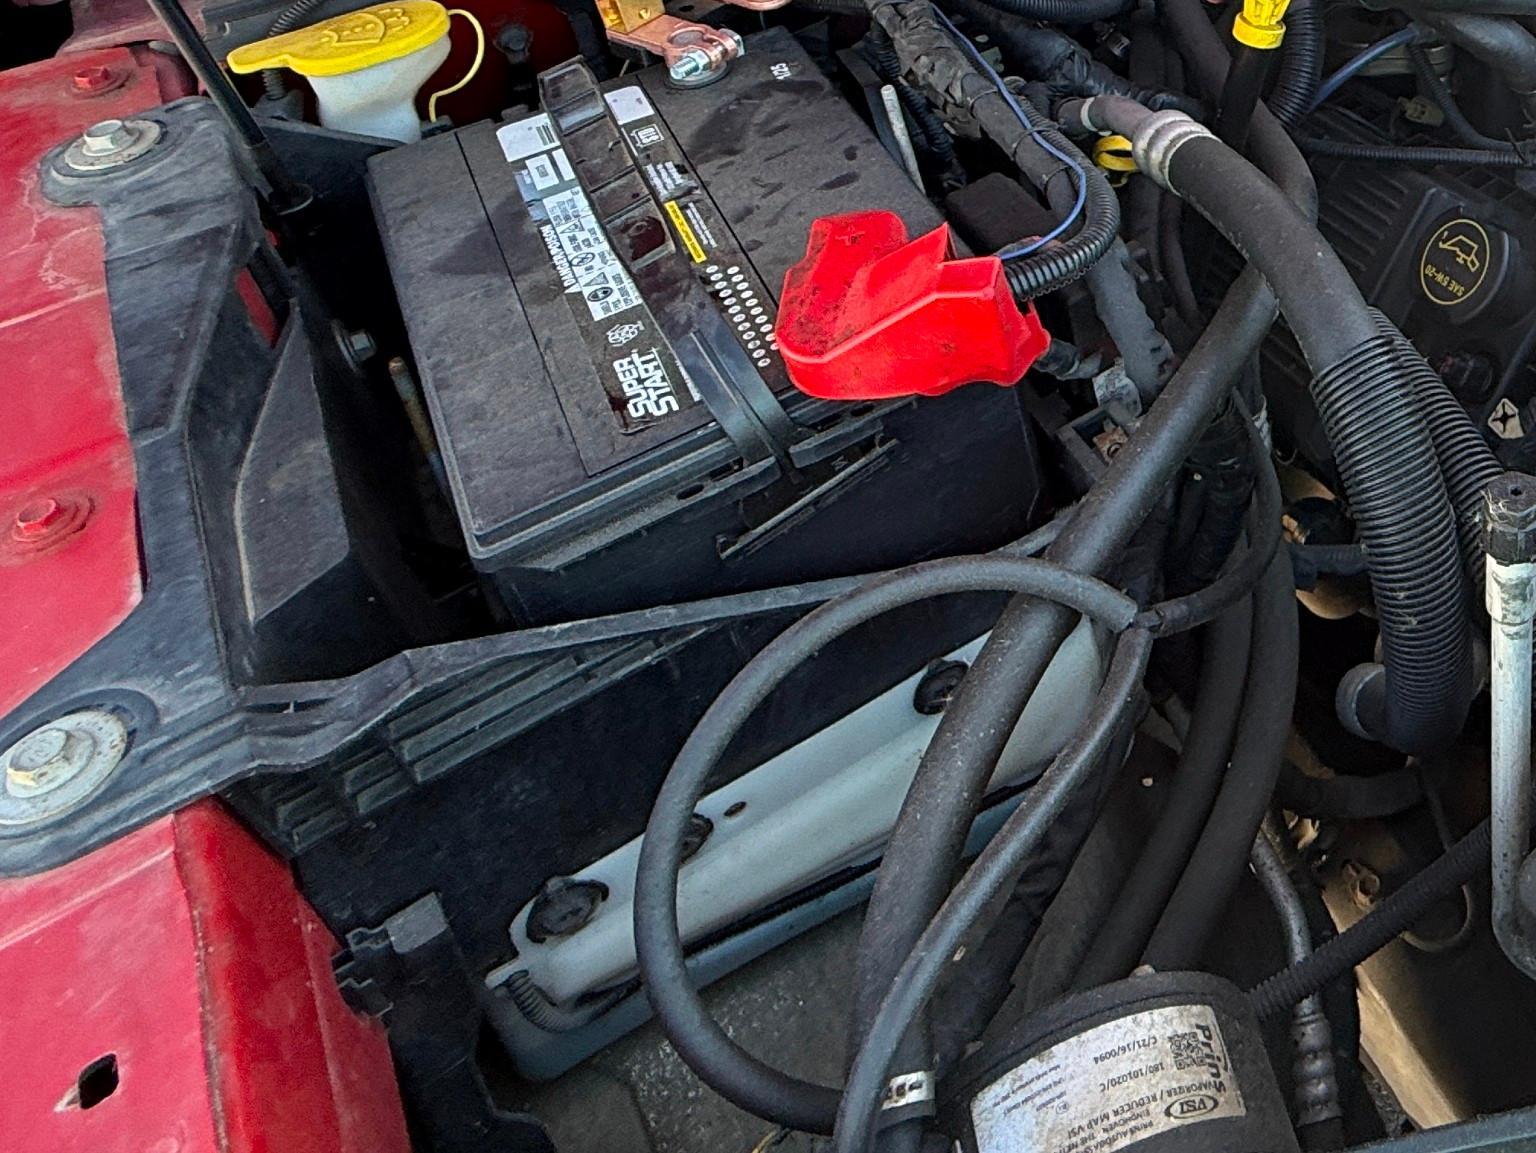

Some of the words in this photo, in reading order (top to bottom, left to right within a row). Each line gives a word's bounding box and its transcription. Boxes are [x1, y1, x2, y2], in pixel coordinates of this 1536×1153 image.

[1425, 264, 1449, 286] 5W-20
[1449, 279, 1465, 296] SAE
[613, 356, 651, 418] SUPER
[637, 346, 679, 417] START
[1099, 1061, 1165, 1092] 180/101020/C
[1112, 1094, 1157, 1117] REDUCER
[1179, 1099, 1208, 1114] VSI
[1067, 1125, 1084, 1140] VSI
[1086, 1113, 1110, 1130] MAP
